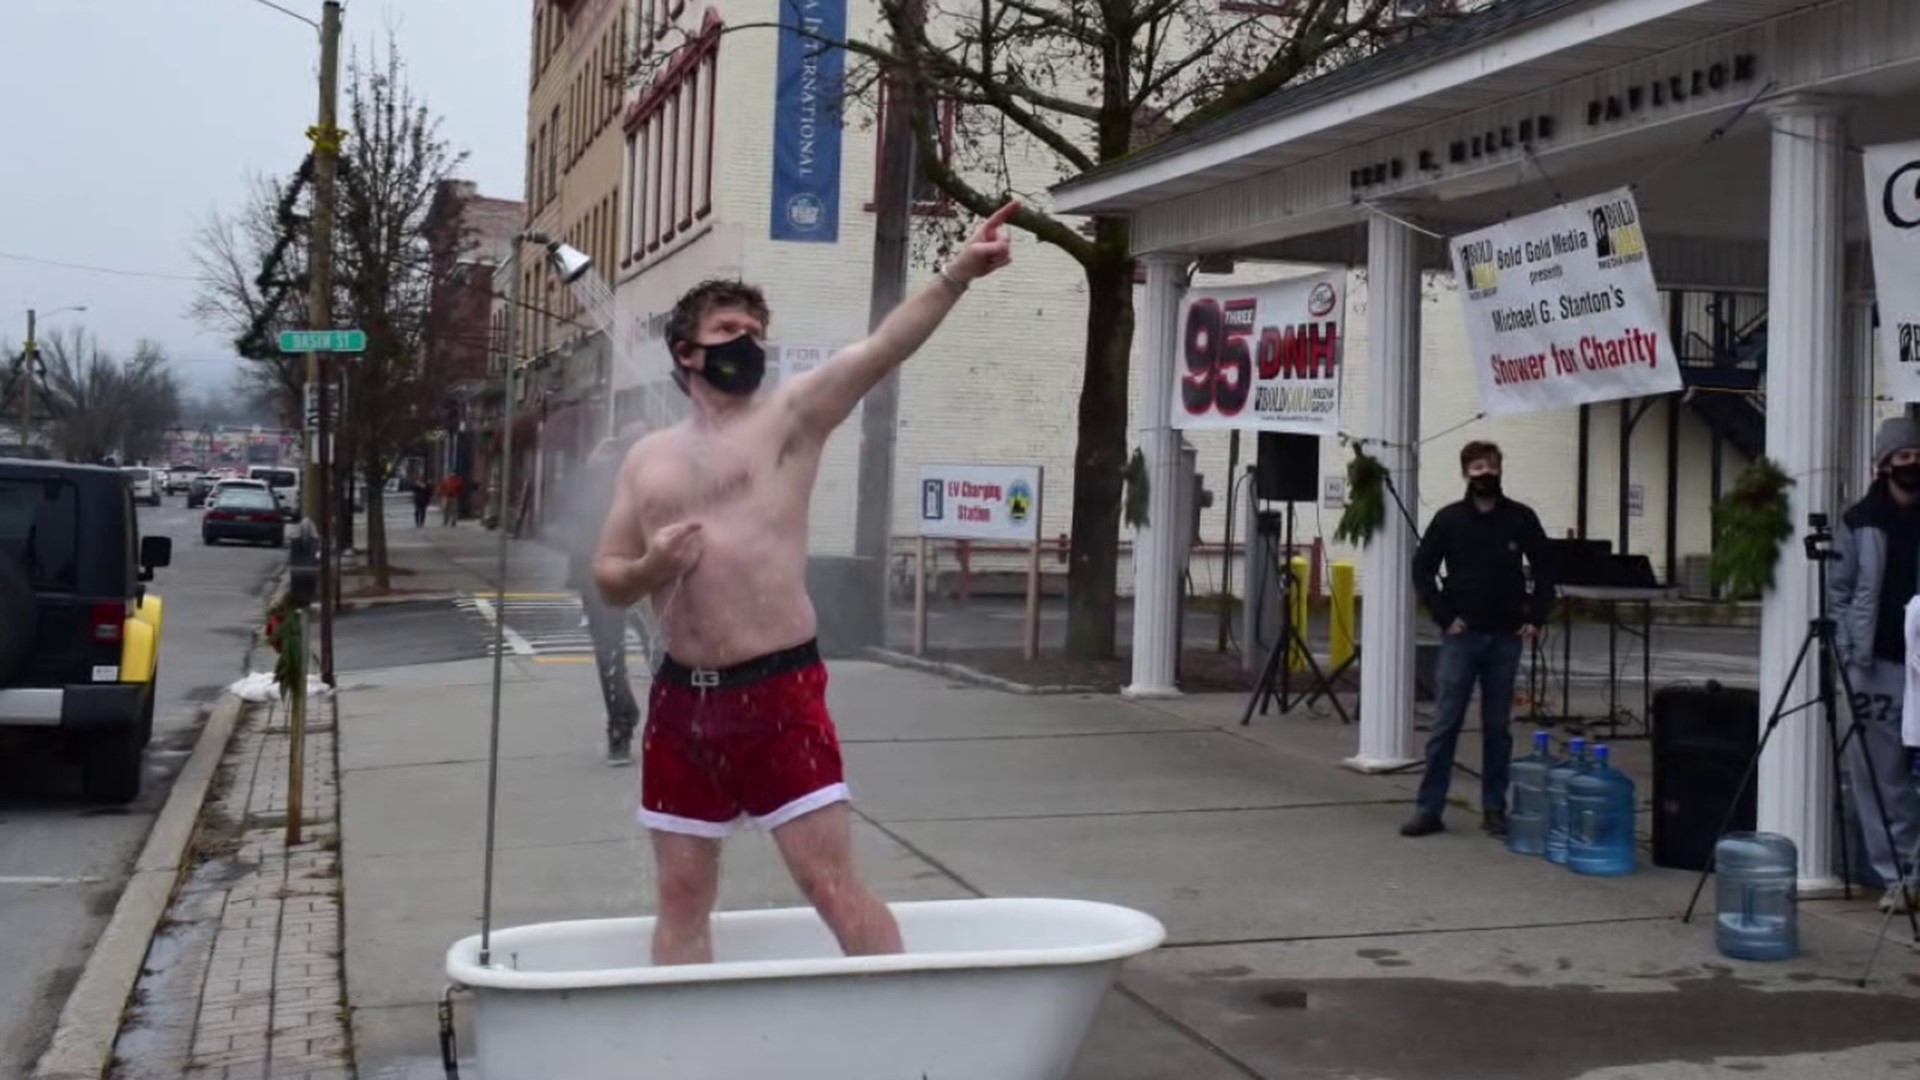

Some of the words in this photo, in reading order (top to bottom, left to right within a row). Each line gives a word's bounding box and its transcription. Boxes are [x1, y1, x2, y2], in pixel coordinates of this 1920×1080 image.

[1588, 54, 1757, 126] PAVILION
[1497, 245, 1522, 270] Bold
[1525, 238, 1552, 263] Gold
[1552, 229, 1588, 255] Media
[1529, 264, 1563, 286] presents
[1224, 310, 1254, 325] THREE
[1492, 302, 1537, 333] Michael
[1540, 300, 1555, 323] G.
[1559, 285, 1625, 321] Stanton's
[1181, 297, 1258, 417] 95
[1257, 321, 1337, 380] DNH
[1491, 353, 1546, 386] Shower
[1551, 342, 1579, 376] for
[1579, 328, 1657, 372] Charity
[948, 482, 960, 497] EV
[962, 480, 1001, 502] Charging
[958, 505, 990, 521] Station
[1854, 692, 1893, 721] 27
